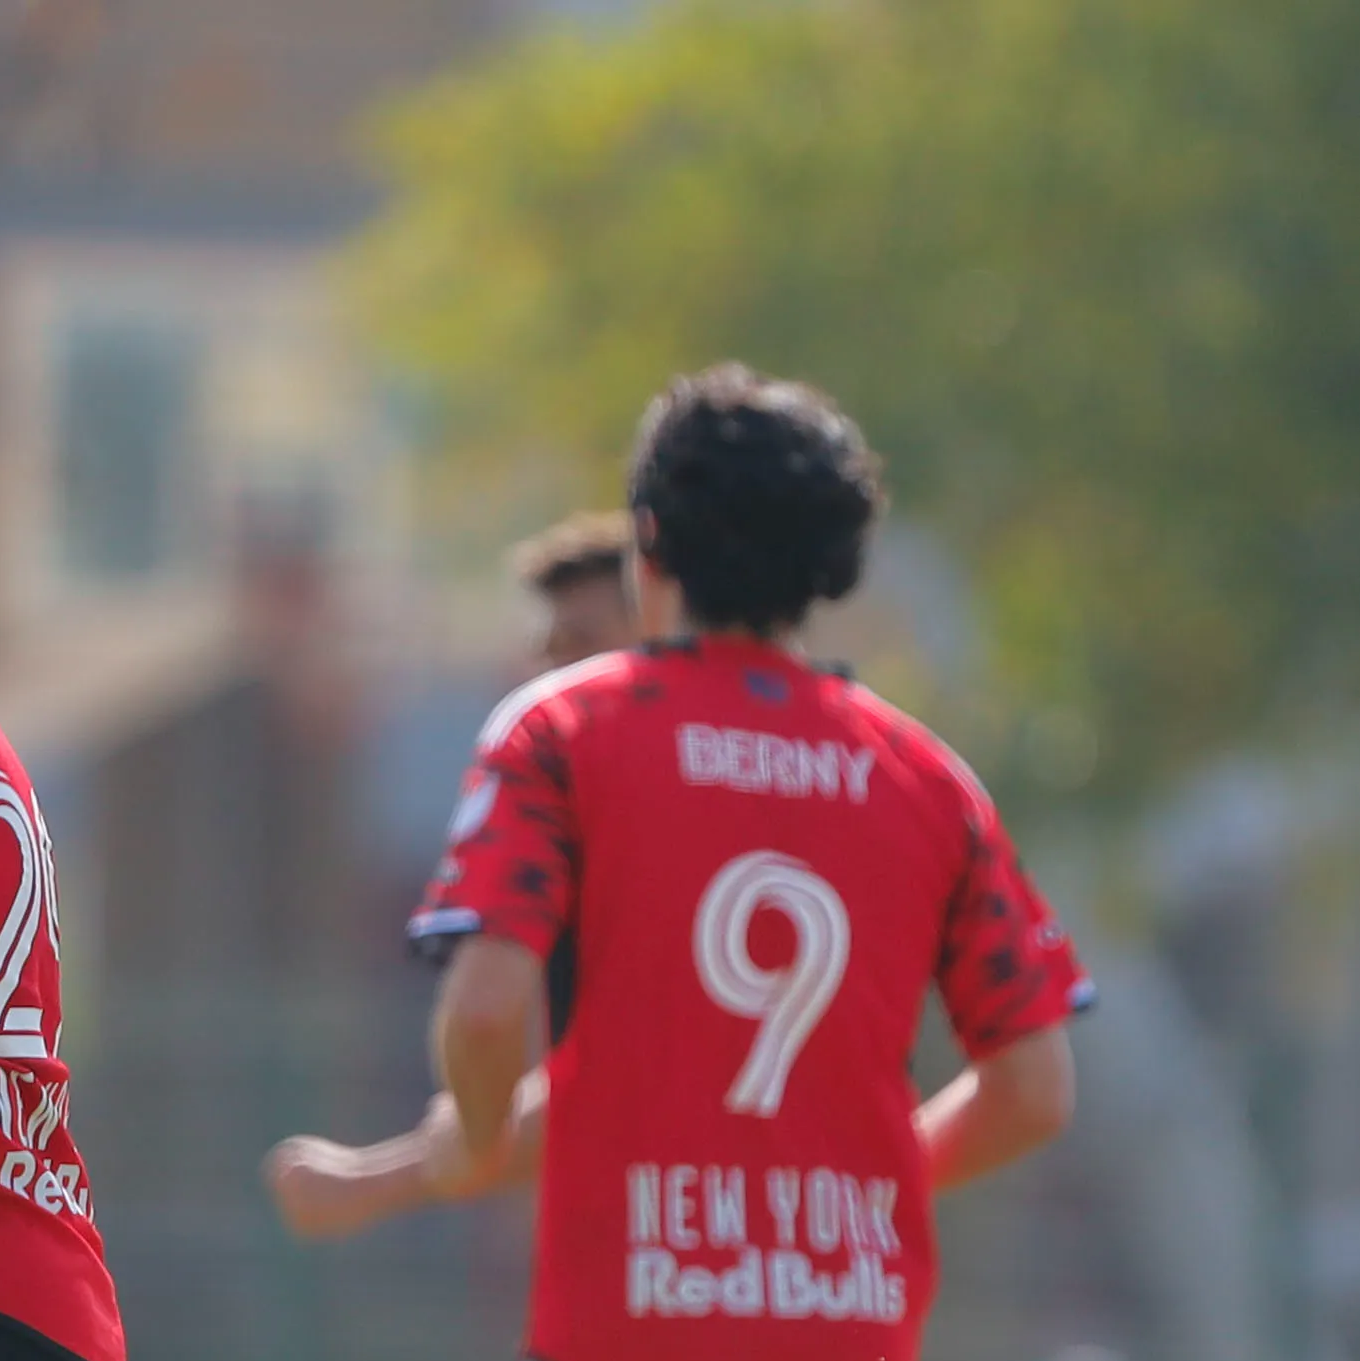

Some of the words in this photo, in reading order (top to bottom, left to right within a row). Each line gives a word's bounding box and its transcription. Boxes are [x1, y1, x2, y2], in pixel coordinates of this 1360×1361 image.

[676, 721, 875, 803] BERNY
[692, 848, 851, 1119] 9
[627, 1161, 747, 1250] NEW
[765, 1165, 902, 1258] YORK
